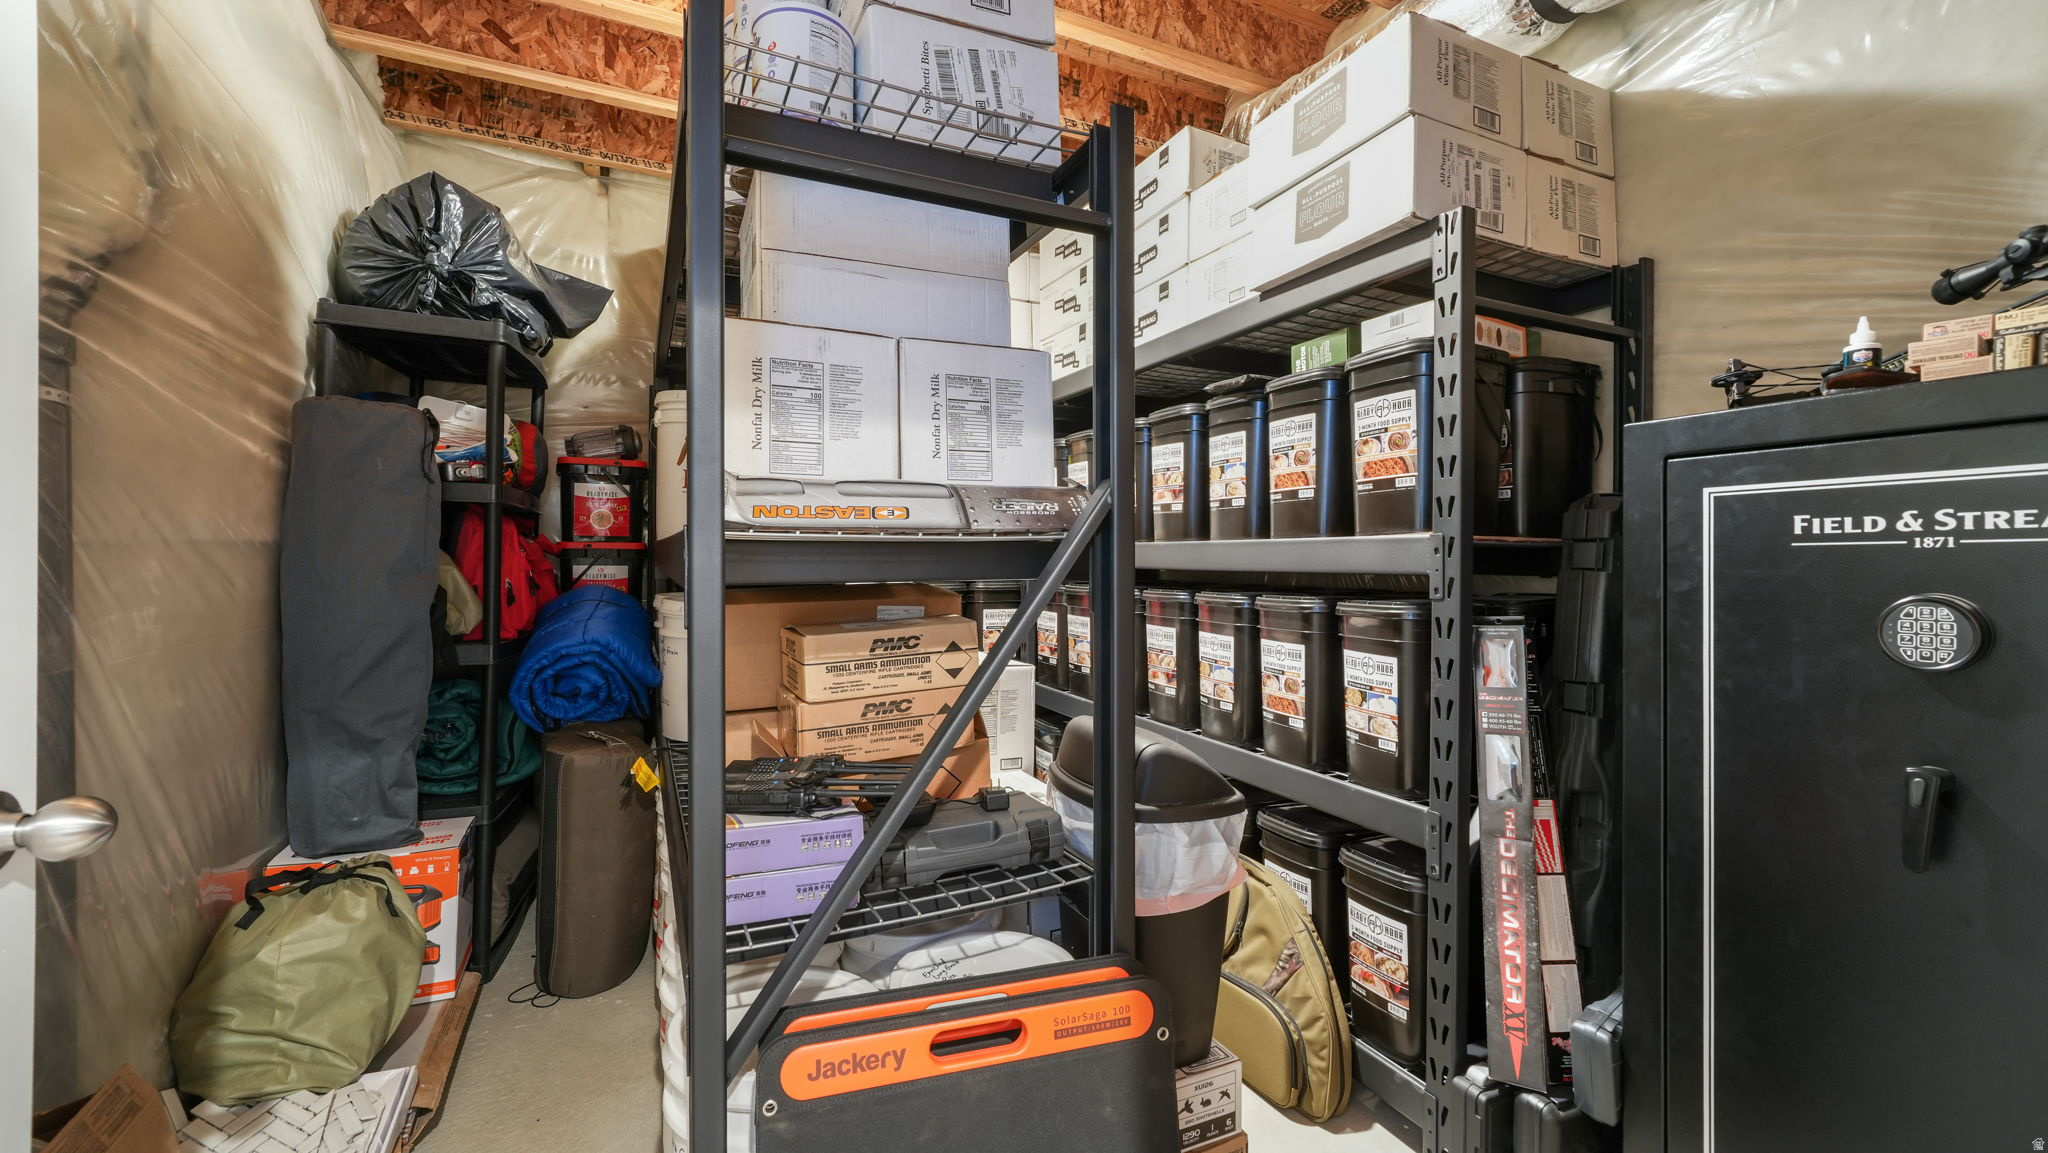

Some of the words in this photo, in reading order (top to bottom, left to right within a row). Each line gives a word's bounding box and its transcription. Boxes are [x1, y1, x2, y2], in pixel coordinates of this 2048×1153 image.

[921, 41, 930, 65] Bites
[922, 67, 934, 116] Spaghetti
[1064, 118, 1078, 130] ESR
[1296, 97, 1343, 139] FLOUR
[426, 118, 453, 130] PEFC
[458, 124, 509, 141] Certified
[1140, 182, 1158, 199] BEANS
[1302, 178, 1344, 206] ALL-PURPOSE
[1300, 191, 1346, 228] FLOUR
[1140, 249, 1157, 266] BEANS
[1140, 314, 1157, 329] BEANS
[1998, 313, 2018, 322] FMJ
[752, 356, 763, 383] Milk
[772, 360, 798, 368] Nutrition
[930, 374, 940, 398] Milk
[752, 387, 766, 408] Dry
[1392, 399, 1412, 410] HOUR
[932, 401, 942, 421] Dry
[752, 412, 763, 450] Nonfat
[1378, 419, 1390, 428] FOOD
[1392, 416, 1412, 424] SUPPLY
[932, 424, 941, 460] Nonfat
[752, 504, 871, 519] EASTON
[992, 500, 1060, 512] RAIDER
[1792, 514, 1887, 534] FIELD
[1895, 510, 1924, 532] &
[1913, 536, 1956, 548] 1871
[868, 634, 921, 654] PMC
[826, 664, 852, 674] SMALL
[854, 661, 878, 670] ARMS
[880, 656, 931, 668] AMMUNITION
[1376, 664, 1394, 674] HOUR
[1376, 680, 1393, 688] SUPPLY
[860, 698, 913, 717] PMC
[817, 730, 843, 739] SMALL
[846, 726, 870, 735] ARMS
[872, 719, 923, 731] AMMUNITION
[1504, 808, 1517, 838] THE
[726, 892, 754, 900] FENG
[1498, 836, 1523, 1004] DECIMATOR
[1370, 933, 1383, 945] FOOD
[1384, 940, 1403, 954] SUPPLY
[1384, 927, 1404, 941] HOUR
[1053, 1008, 1108, 1028] SolarSaga
[1112, 1005, 1131, 1016] 100
[807, 1048, 906, 1082] Jackery
[1196, 1109, 1225, 1122] SHOTSHELLS
[1182, 1129, 1200, 1140] 1290
